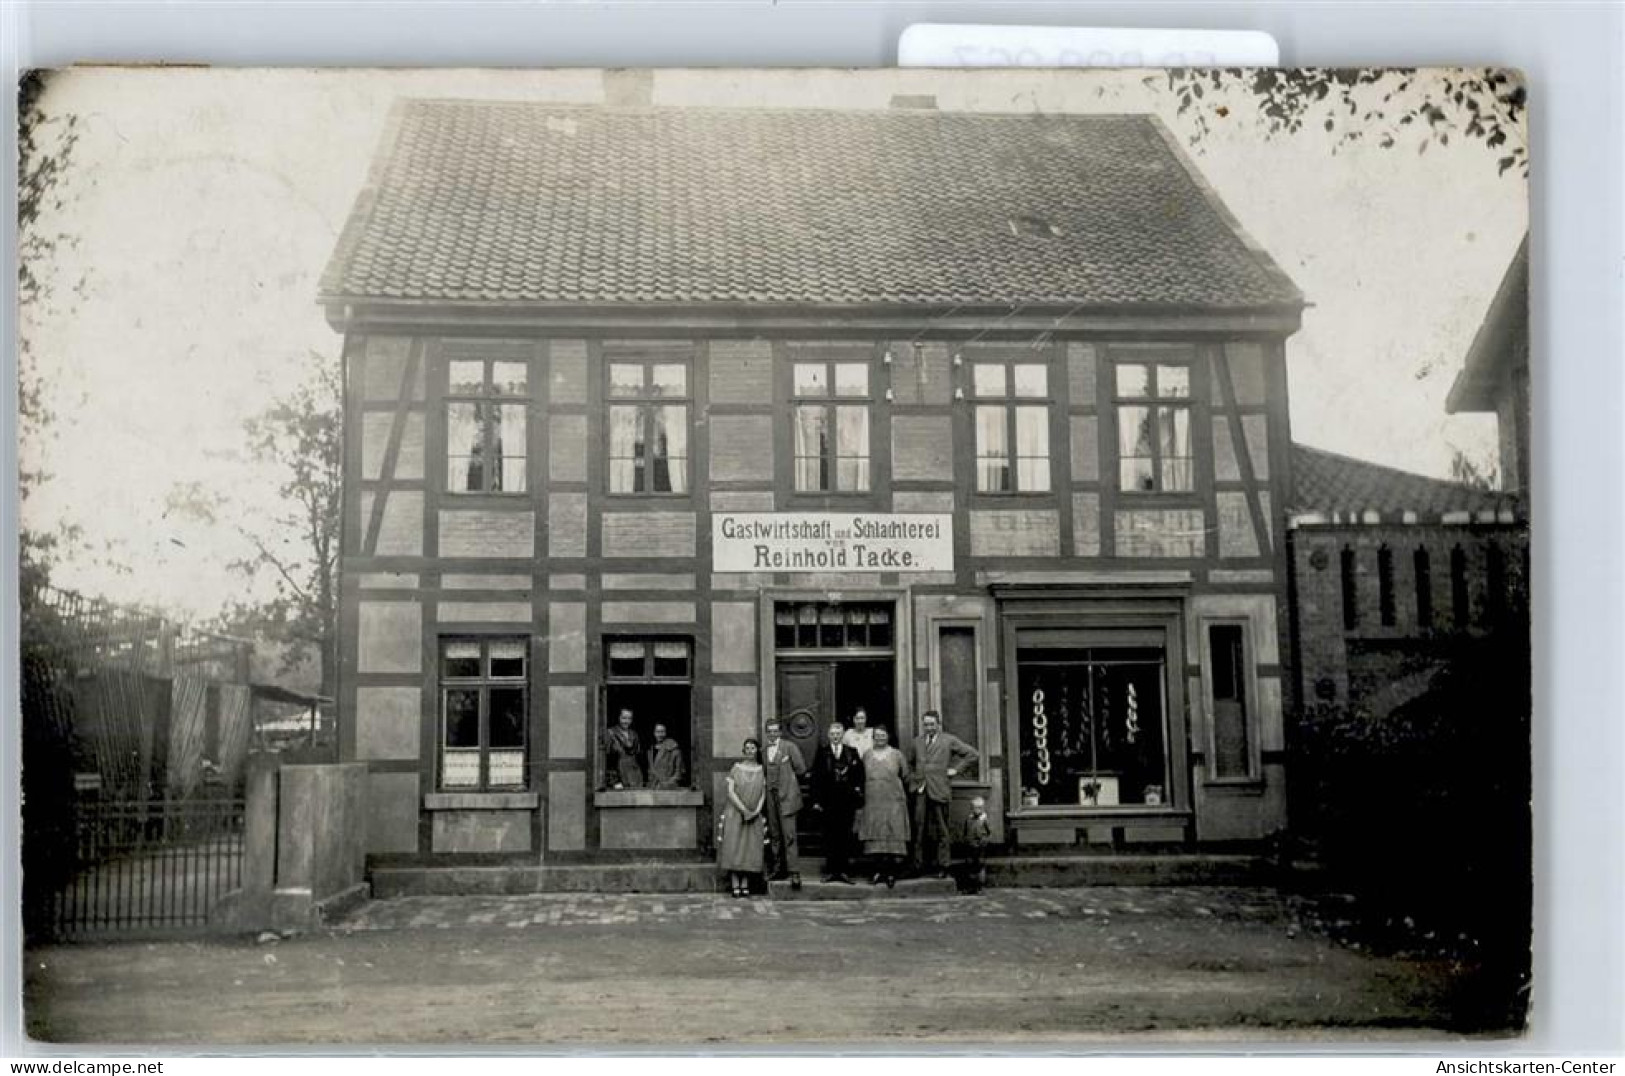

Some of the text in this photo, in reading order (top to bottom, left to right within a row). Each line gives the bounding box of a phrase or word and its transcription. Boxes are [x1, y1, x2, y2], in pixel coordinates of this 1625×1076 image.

[721, 517, 831, 539] Gastwirtschaft
[853, 517, 941, 539] Schlachterei
[753, 545, 919, 568] Reinhold Tacke.
